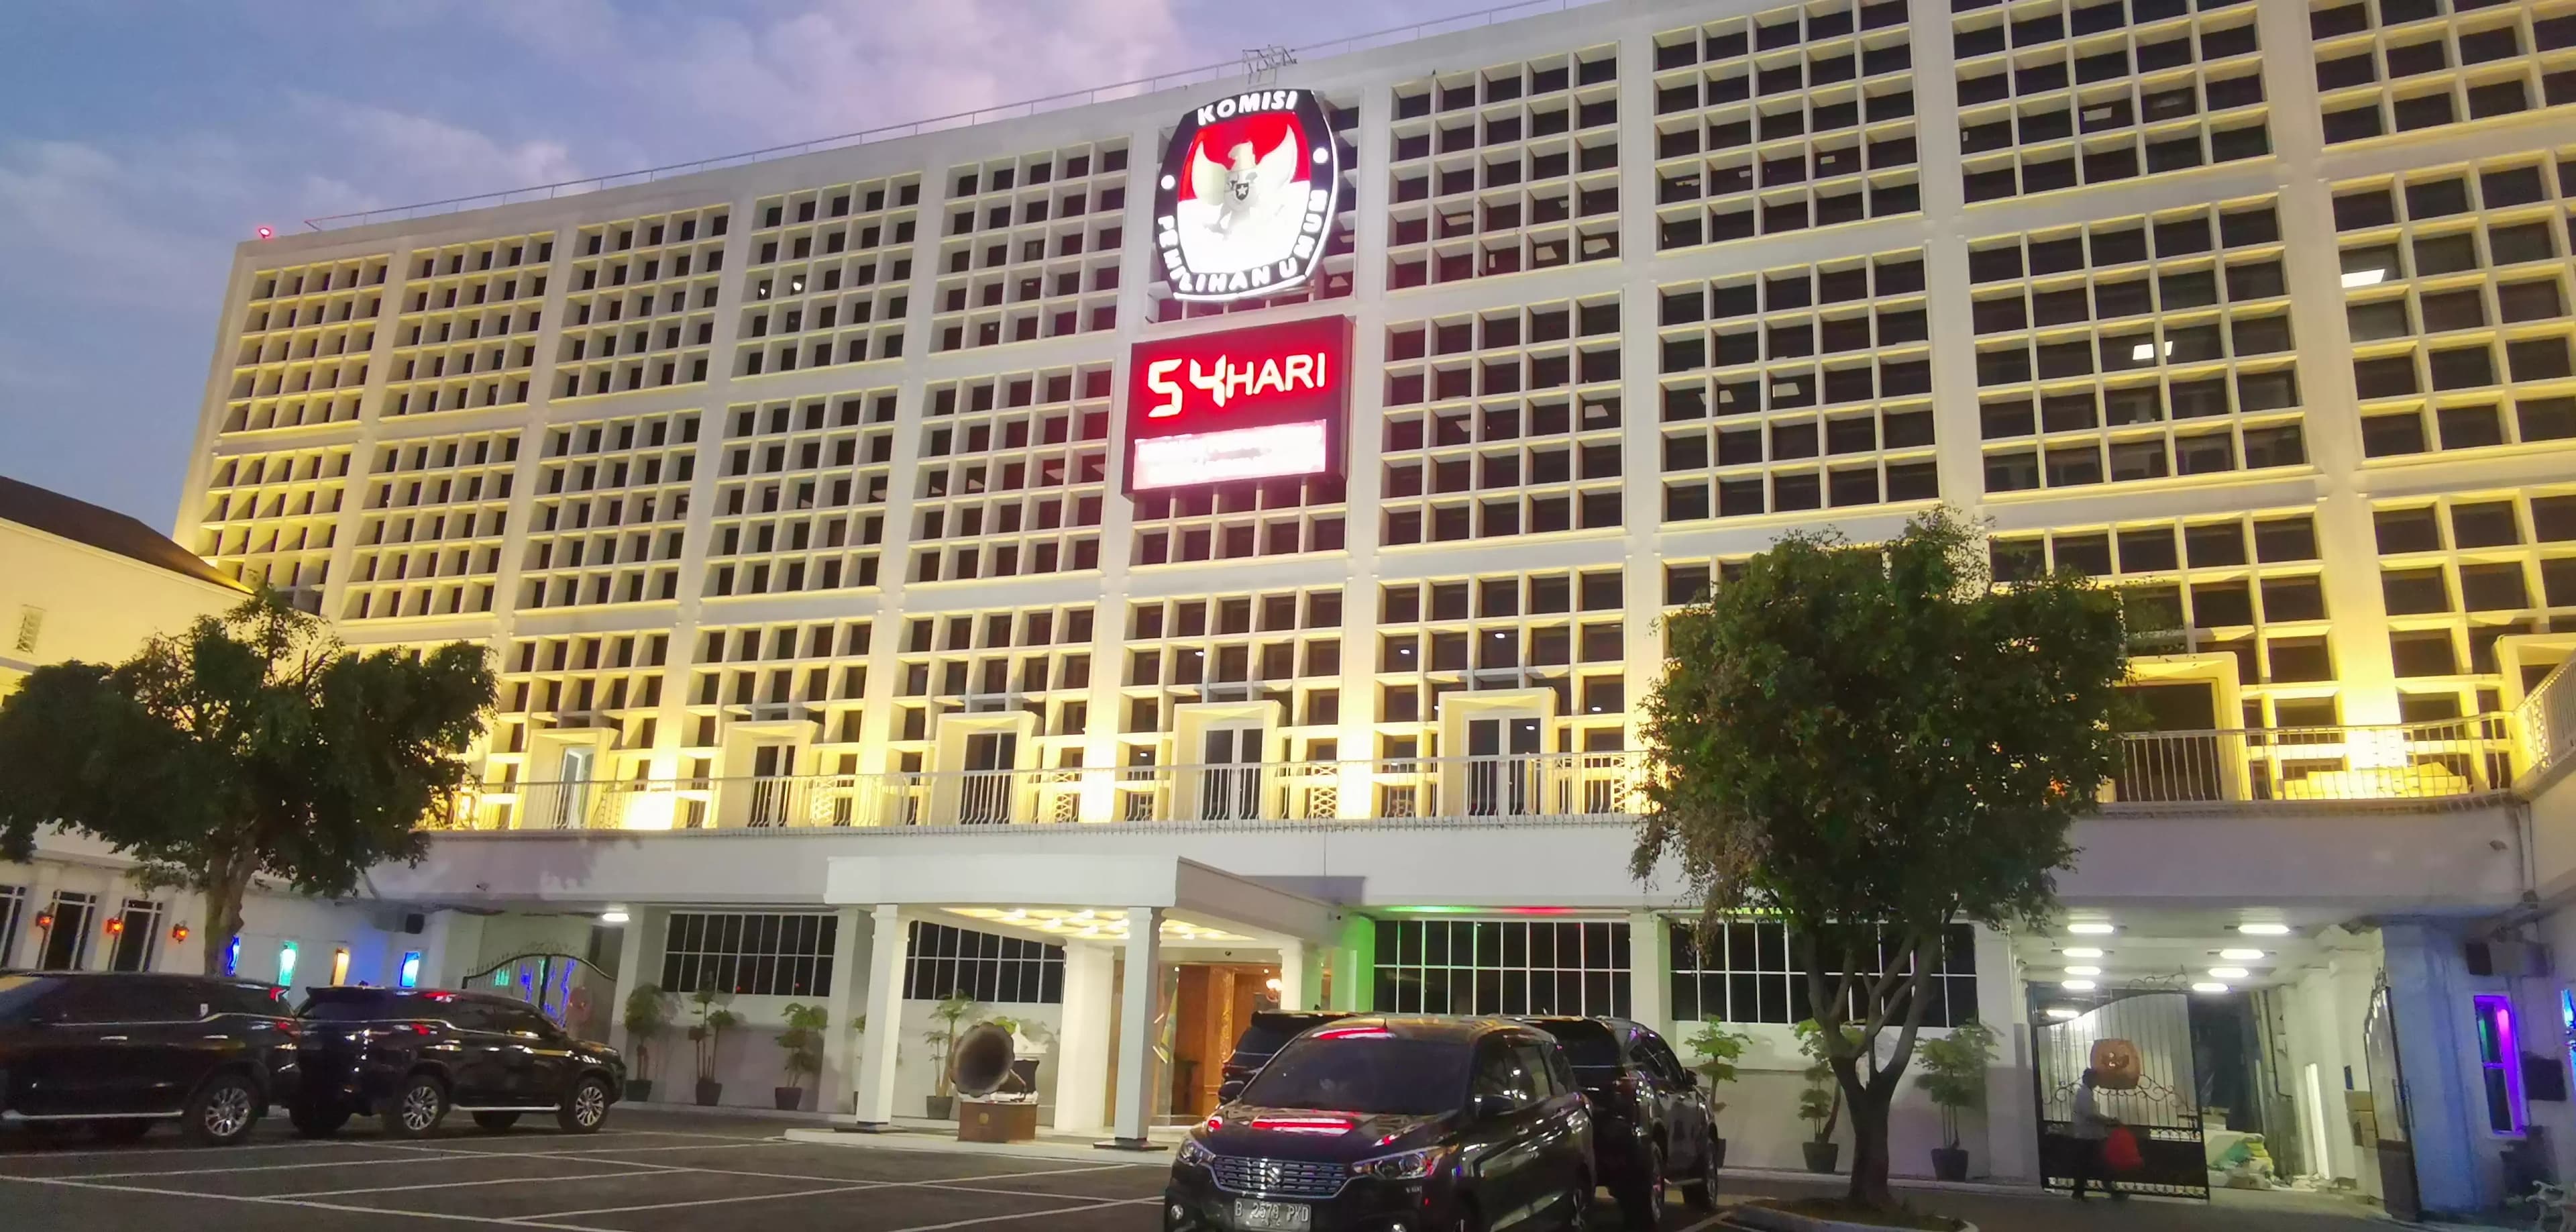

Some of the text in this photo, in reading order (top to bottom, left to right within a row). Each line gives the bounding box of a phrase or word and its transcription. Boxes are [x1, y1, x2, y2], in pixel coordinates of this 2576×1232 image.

[1197, 91, 1297, 125] KOMISI
[1158, 189, 1328, 293] PEMILIHAN UMUM
[1148, 352, 1326, 417] 54 HARI
[1235, 1201, 1242, 1217] B
[1286, 1204, 1309, 1222] PKD
